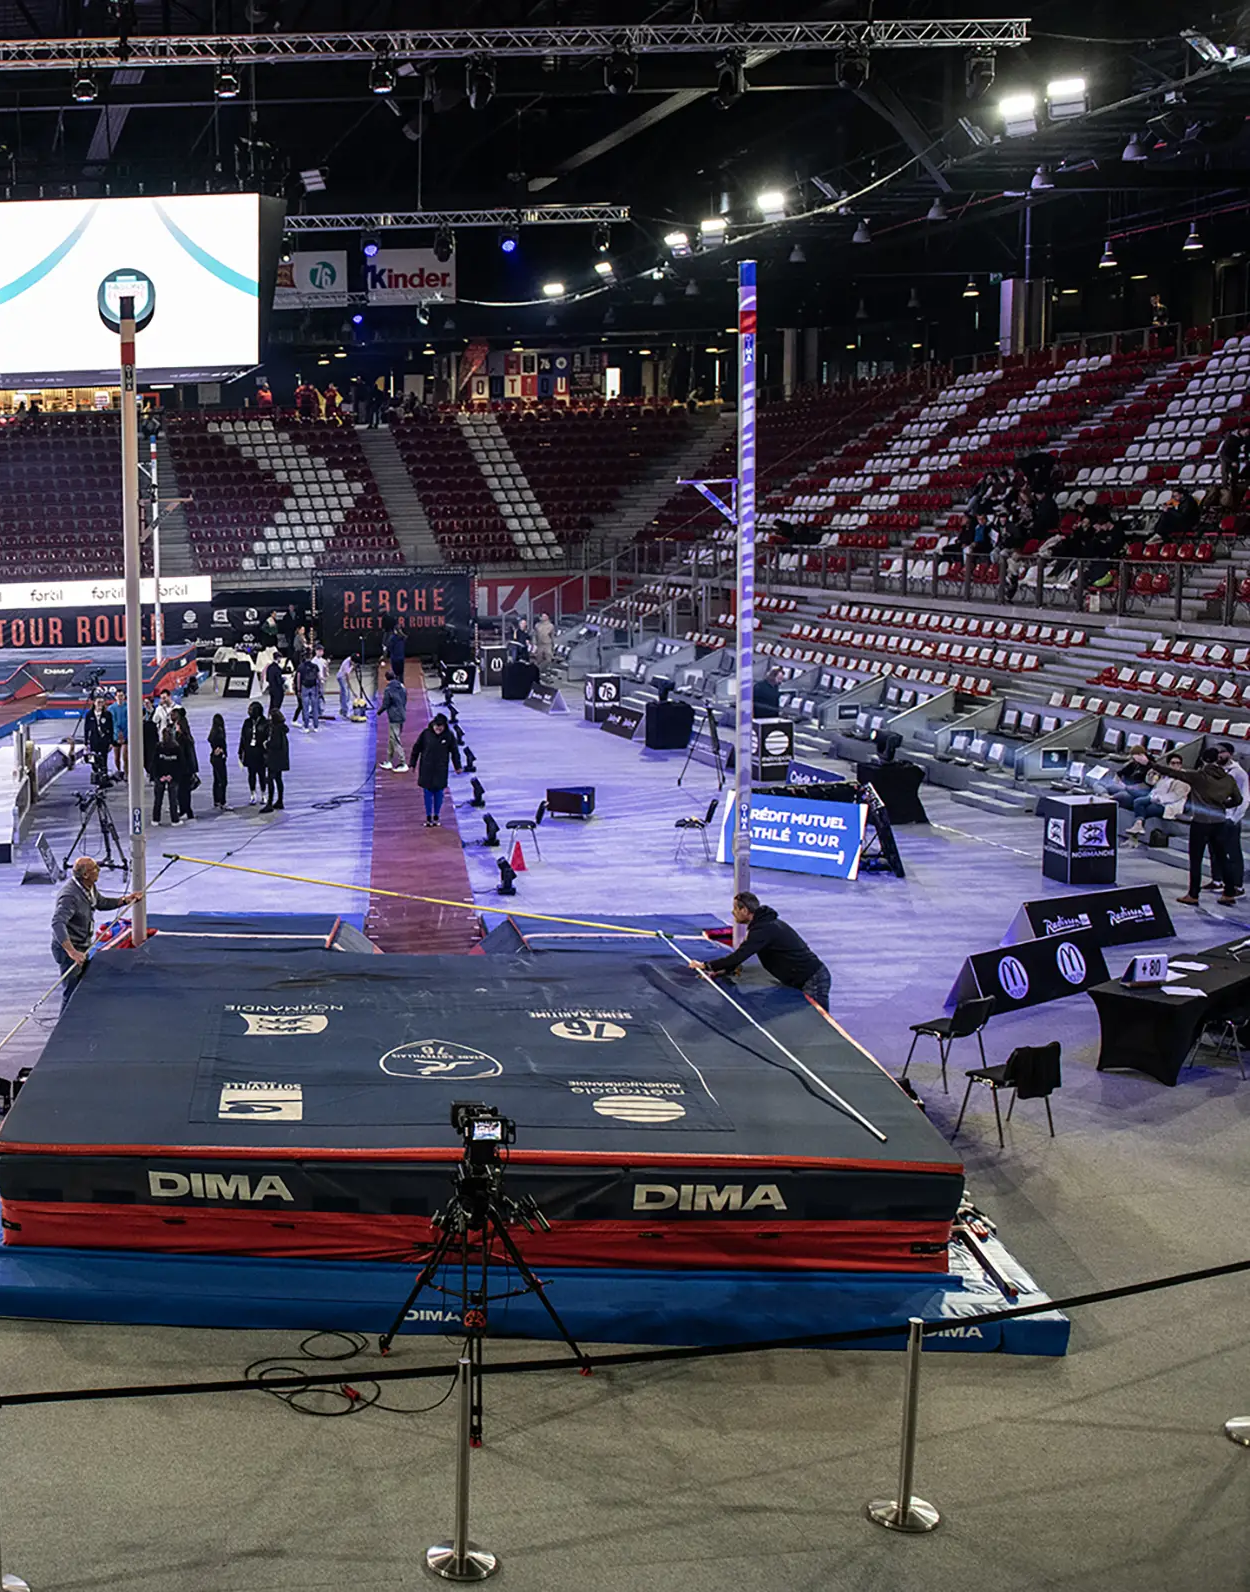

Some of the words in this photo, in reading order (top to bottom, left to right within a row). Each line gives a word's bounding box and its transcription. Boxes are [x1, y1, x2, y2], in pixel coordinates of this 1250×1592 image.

[344, 588, 444, 613] PERCHE
[76, 612, 164, 644] ROUN
[343, 615, 373, 629] ÉLITE
[377, 616, 405, 629] TR
[410, 615, 445, 627] ROUEN
[750, 807, 791, 824] RÉDIT
[791, 812, 847, 830] MUTUEL
[750, 826, 791, 842] THLÉ
[797, 831, 839, 848] TOUR
[1072, 849, 1115, 858] NORMANDIE
[148, 1170, 295, 1201] DIMA
[633, 1184, 787, 1211] DIMA
[404, 1310, 461, 1321] DIMA
[922, 1326, 983, 1338] IMA
